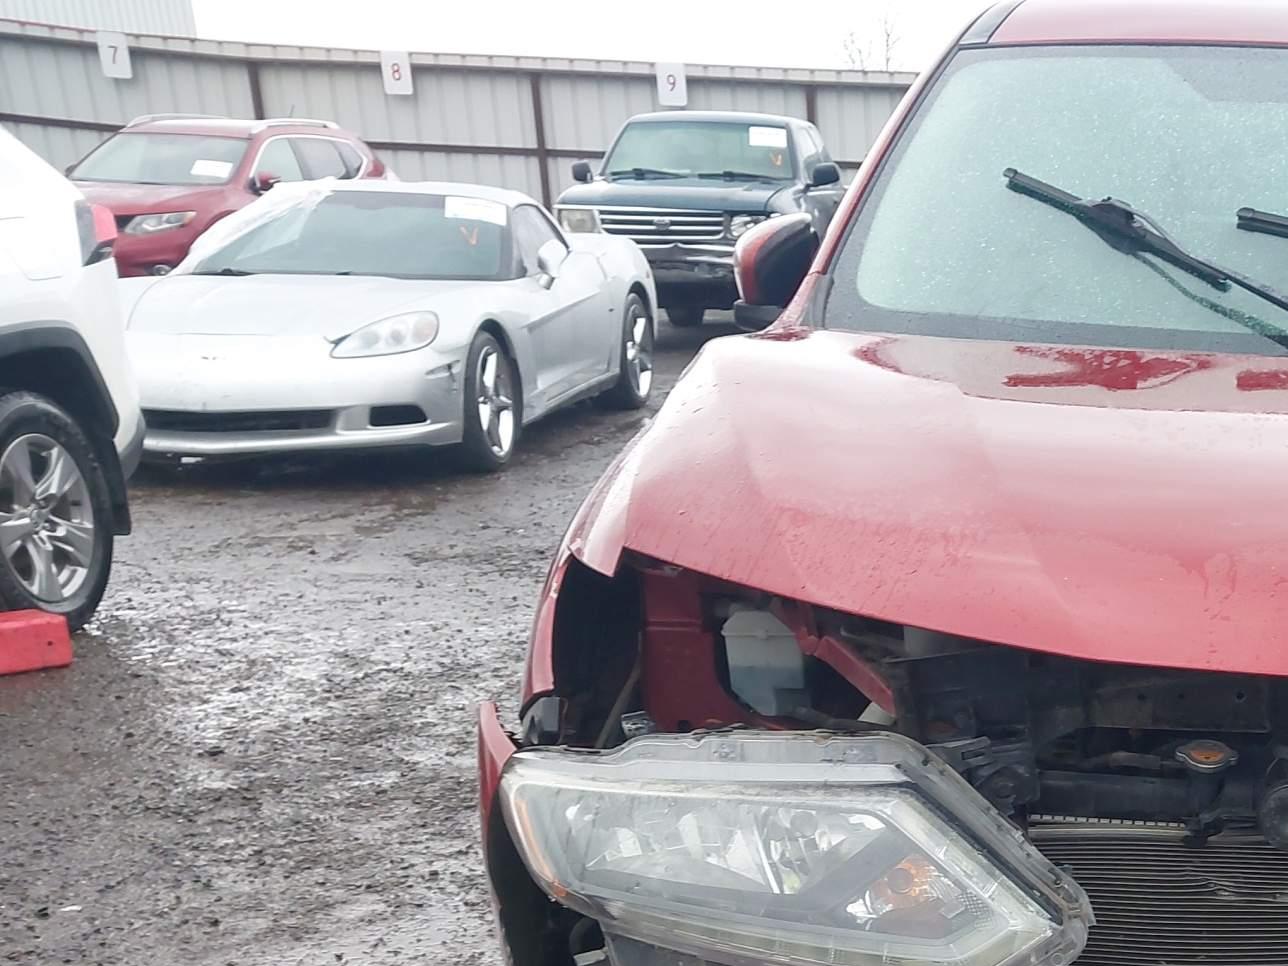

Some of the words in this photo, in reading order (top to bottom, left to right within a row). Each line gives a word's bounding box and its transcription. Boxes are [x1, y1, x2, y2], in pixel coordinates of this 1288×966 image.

[107, 45, 118, 65] 7
[391, 62, 401, 81] 8
[666, 74, 676, 91] 9
